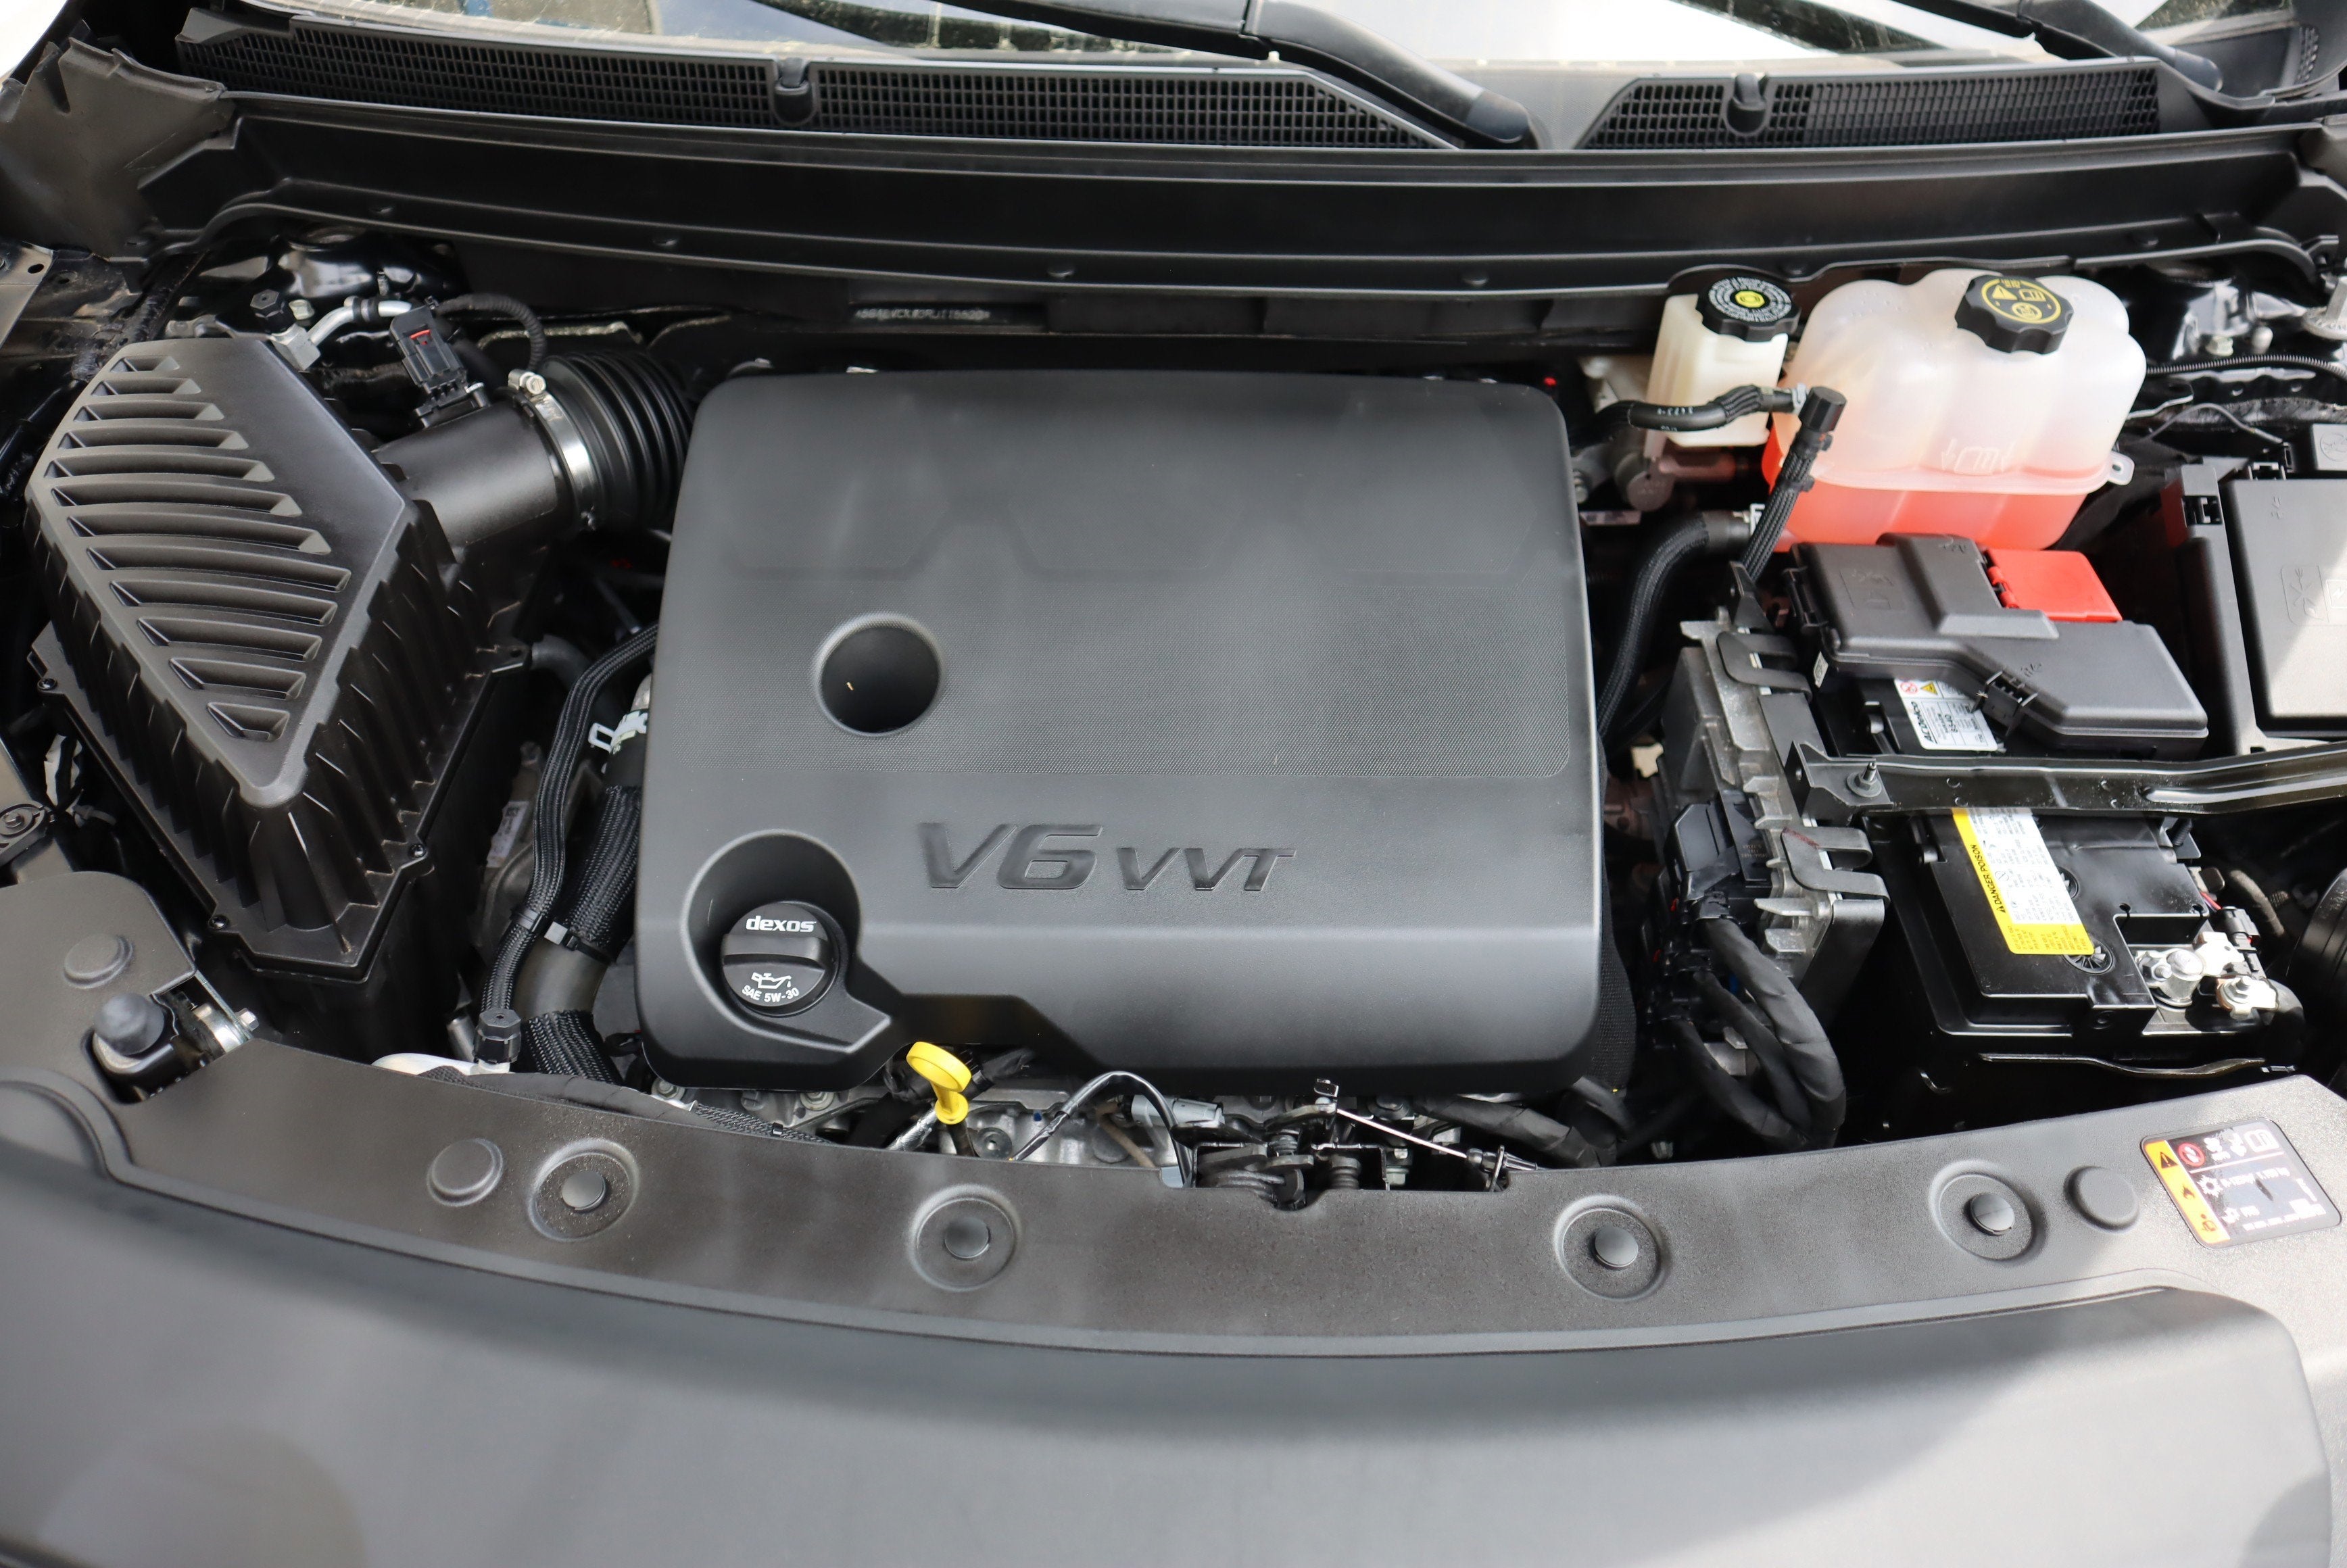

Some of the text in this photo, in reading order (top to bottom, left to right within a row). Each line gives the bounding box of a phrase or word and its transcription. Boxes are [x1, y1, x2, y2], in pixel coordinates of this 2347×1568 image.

[918, 823, 1297, 891] V6 VVT
[1970, 844, 2002, 904] DANGER POISON
[746, 915, 816, 933] dexos
[742, 985, 800, 1002] SAE 5W-30
